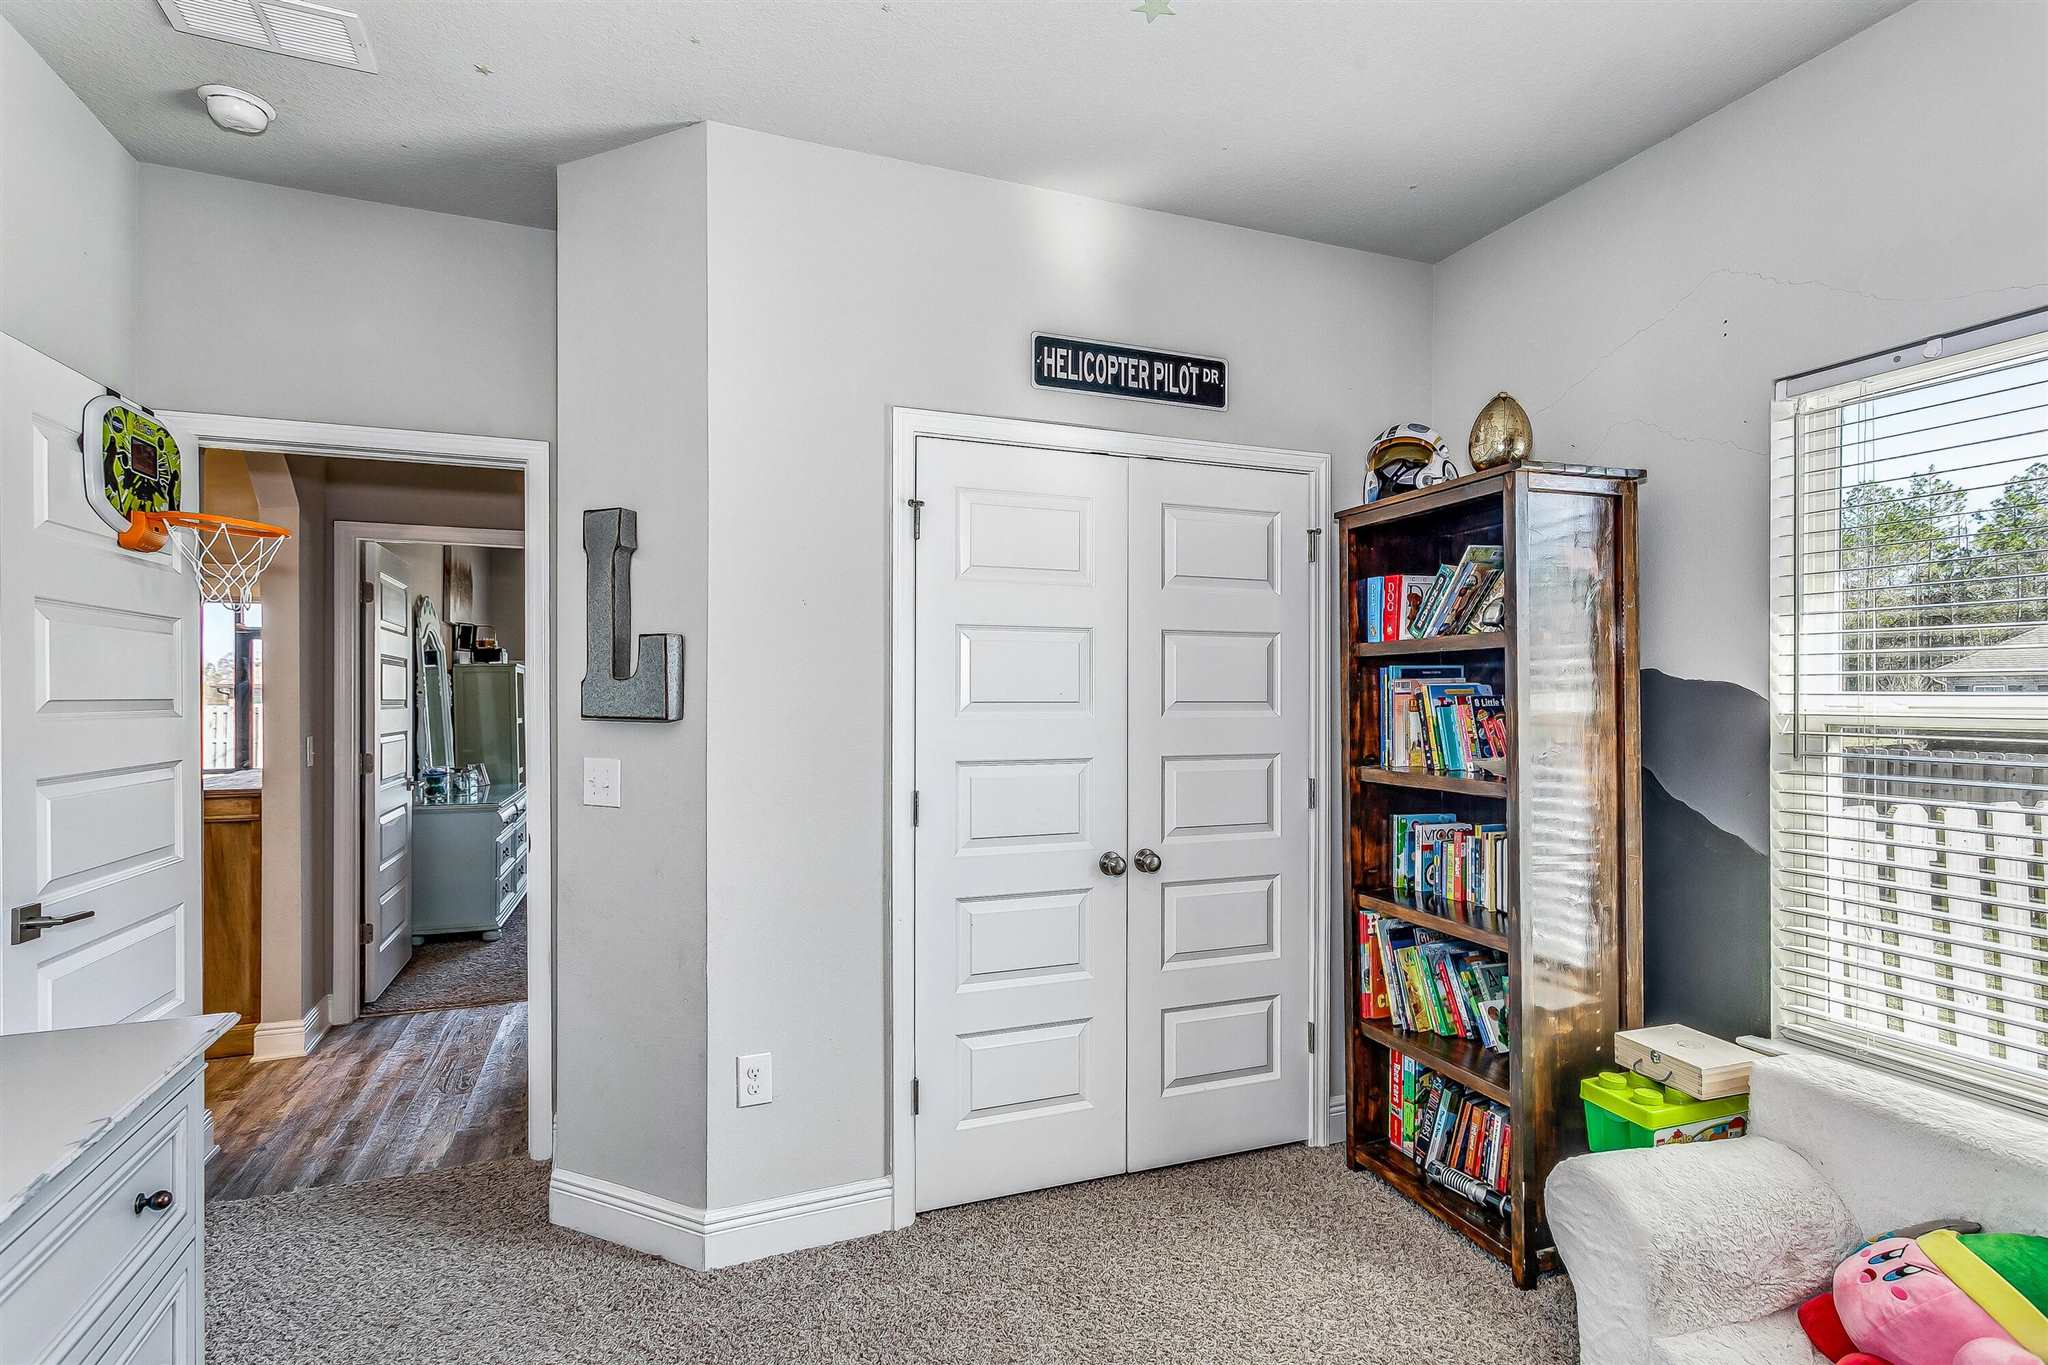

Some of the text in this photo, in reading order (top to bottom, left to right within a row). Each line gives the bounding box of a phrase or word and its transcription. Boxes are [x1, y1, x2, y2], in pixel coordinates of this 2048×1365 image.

[1043, 346, 1219, 396] HELICOPTER PILOT DR
[581, 507, 684, 722] L
